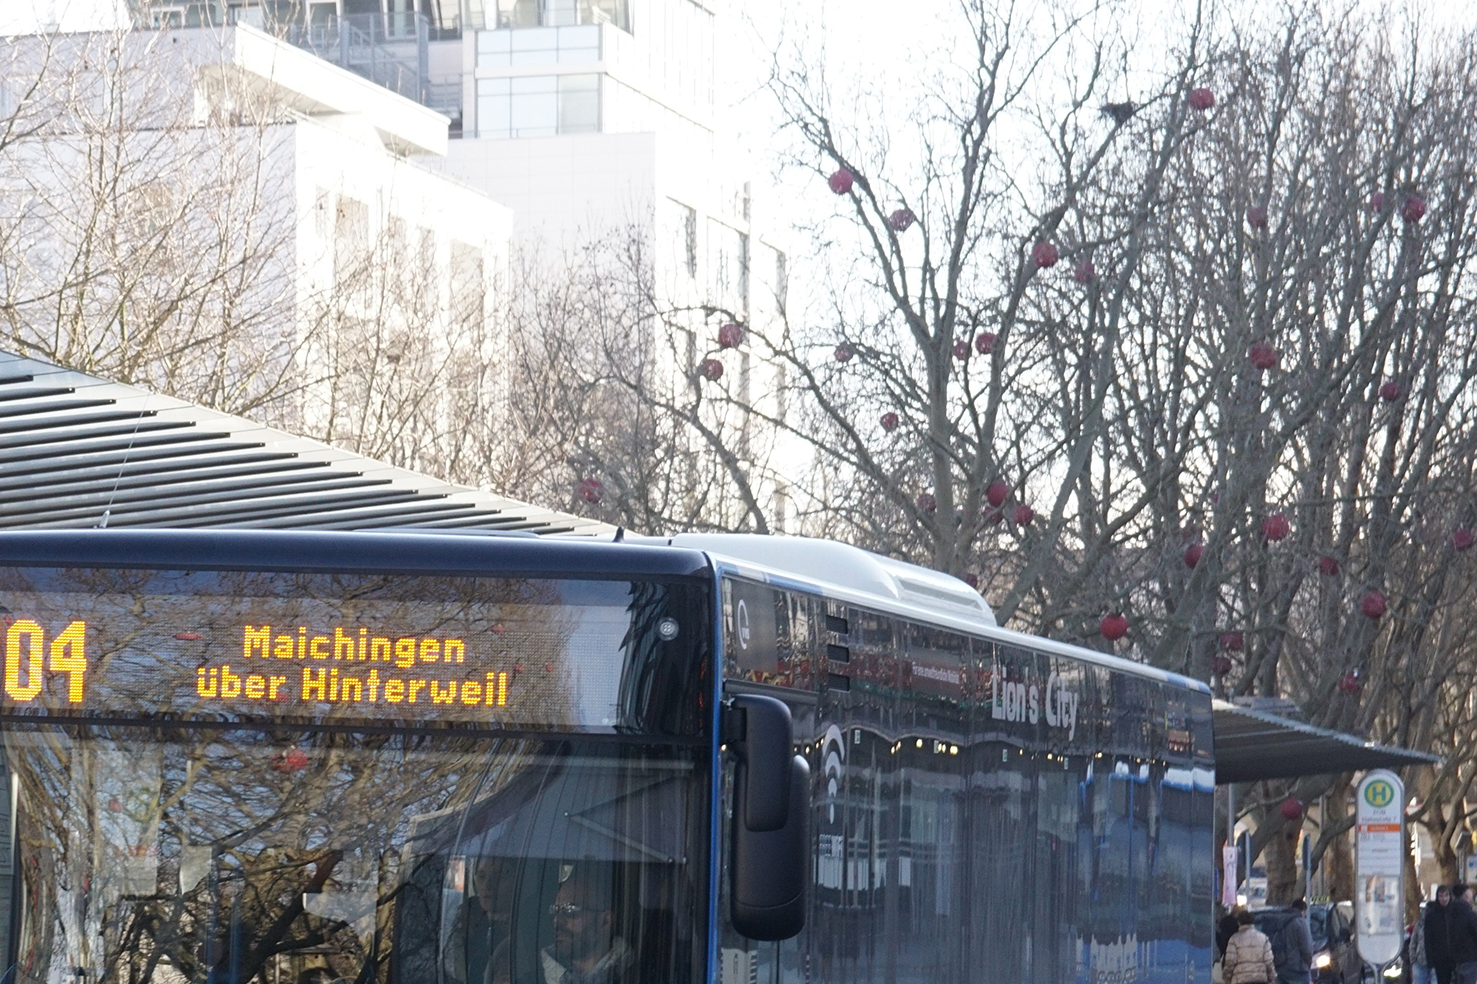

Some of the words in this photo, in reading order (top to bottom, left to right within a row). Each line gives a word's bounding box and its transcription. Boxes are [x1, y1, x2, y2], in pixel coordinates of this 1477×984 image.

[243, 625, 466, 668] Maichingen
[196, 666, 286, 700] über
[302, 667, 508, 707] Hinterweil
[991, 663, 1039, 725] Lion's
[1045, 670, 1078, 742] City
